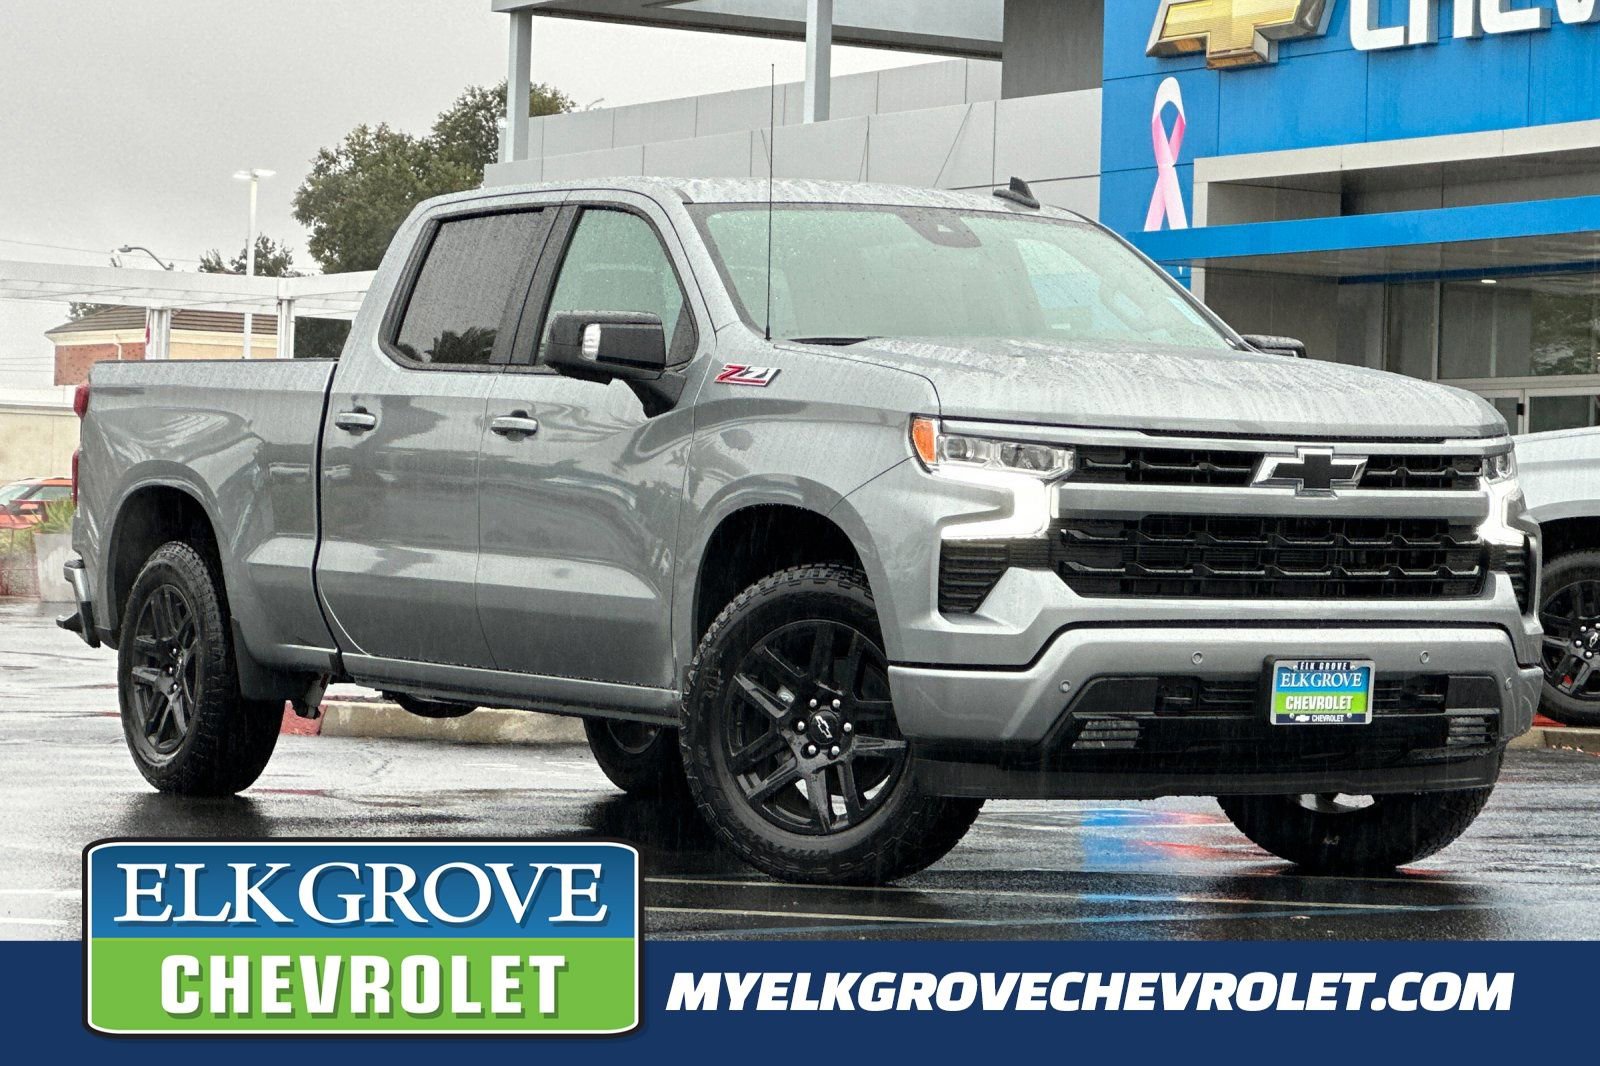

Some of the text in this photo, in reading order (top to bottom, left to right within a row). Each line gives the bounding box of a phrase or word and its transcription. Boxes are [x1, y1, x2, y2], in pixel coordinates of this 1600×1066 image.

[714, 363, 781, 387] Z71
[1300, 661, 1348, 670] ELK GROVE
[1280, 672, 1362, 687] ELK GROVE
[1285, 695, 1353, 710] CHEVROLET
[1311, 714, 1344, 722] CHEVROLET
